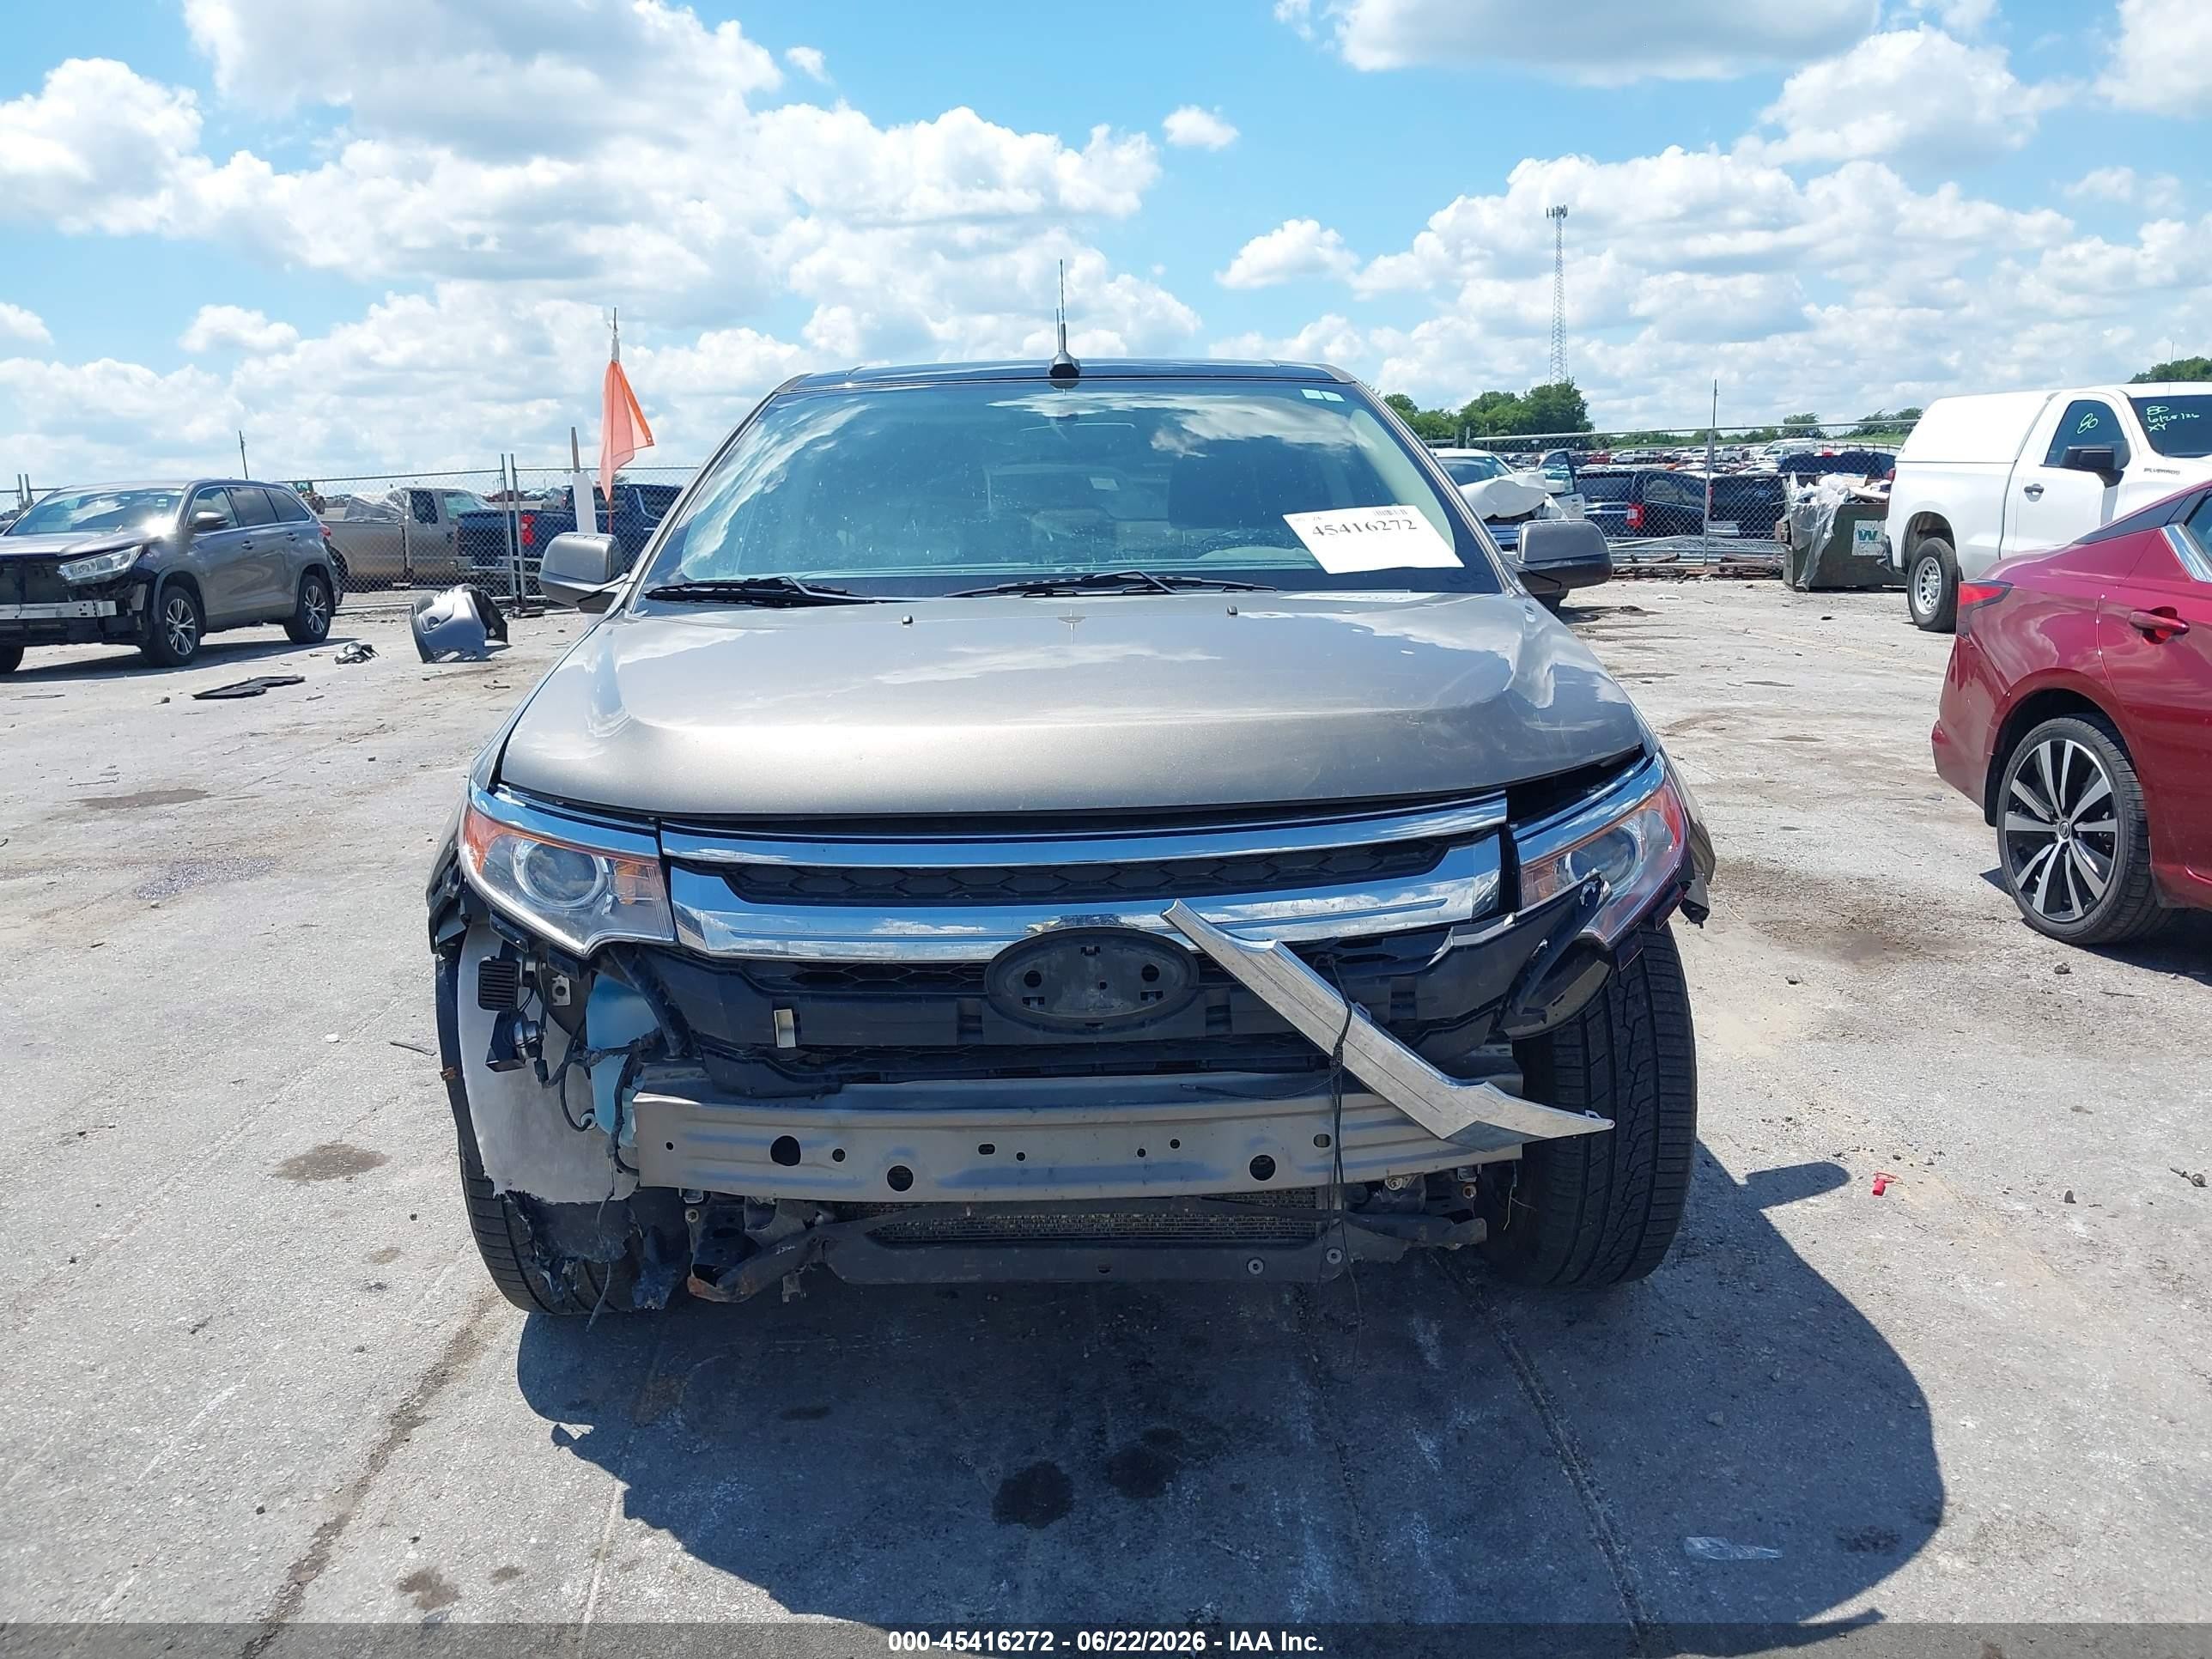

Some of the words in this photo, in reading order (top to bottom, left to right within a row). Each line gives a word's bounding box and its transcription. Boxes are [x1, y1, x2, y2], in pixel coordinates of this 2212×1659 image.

[2147, 405, 2170, 416] 80
[2077, 413, 2098, 434] 80
[1312, 520, 1418, 536] 45416272
